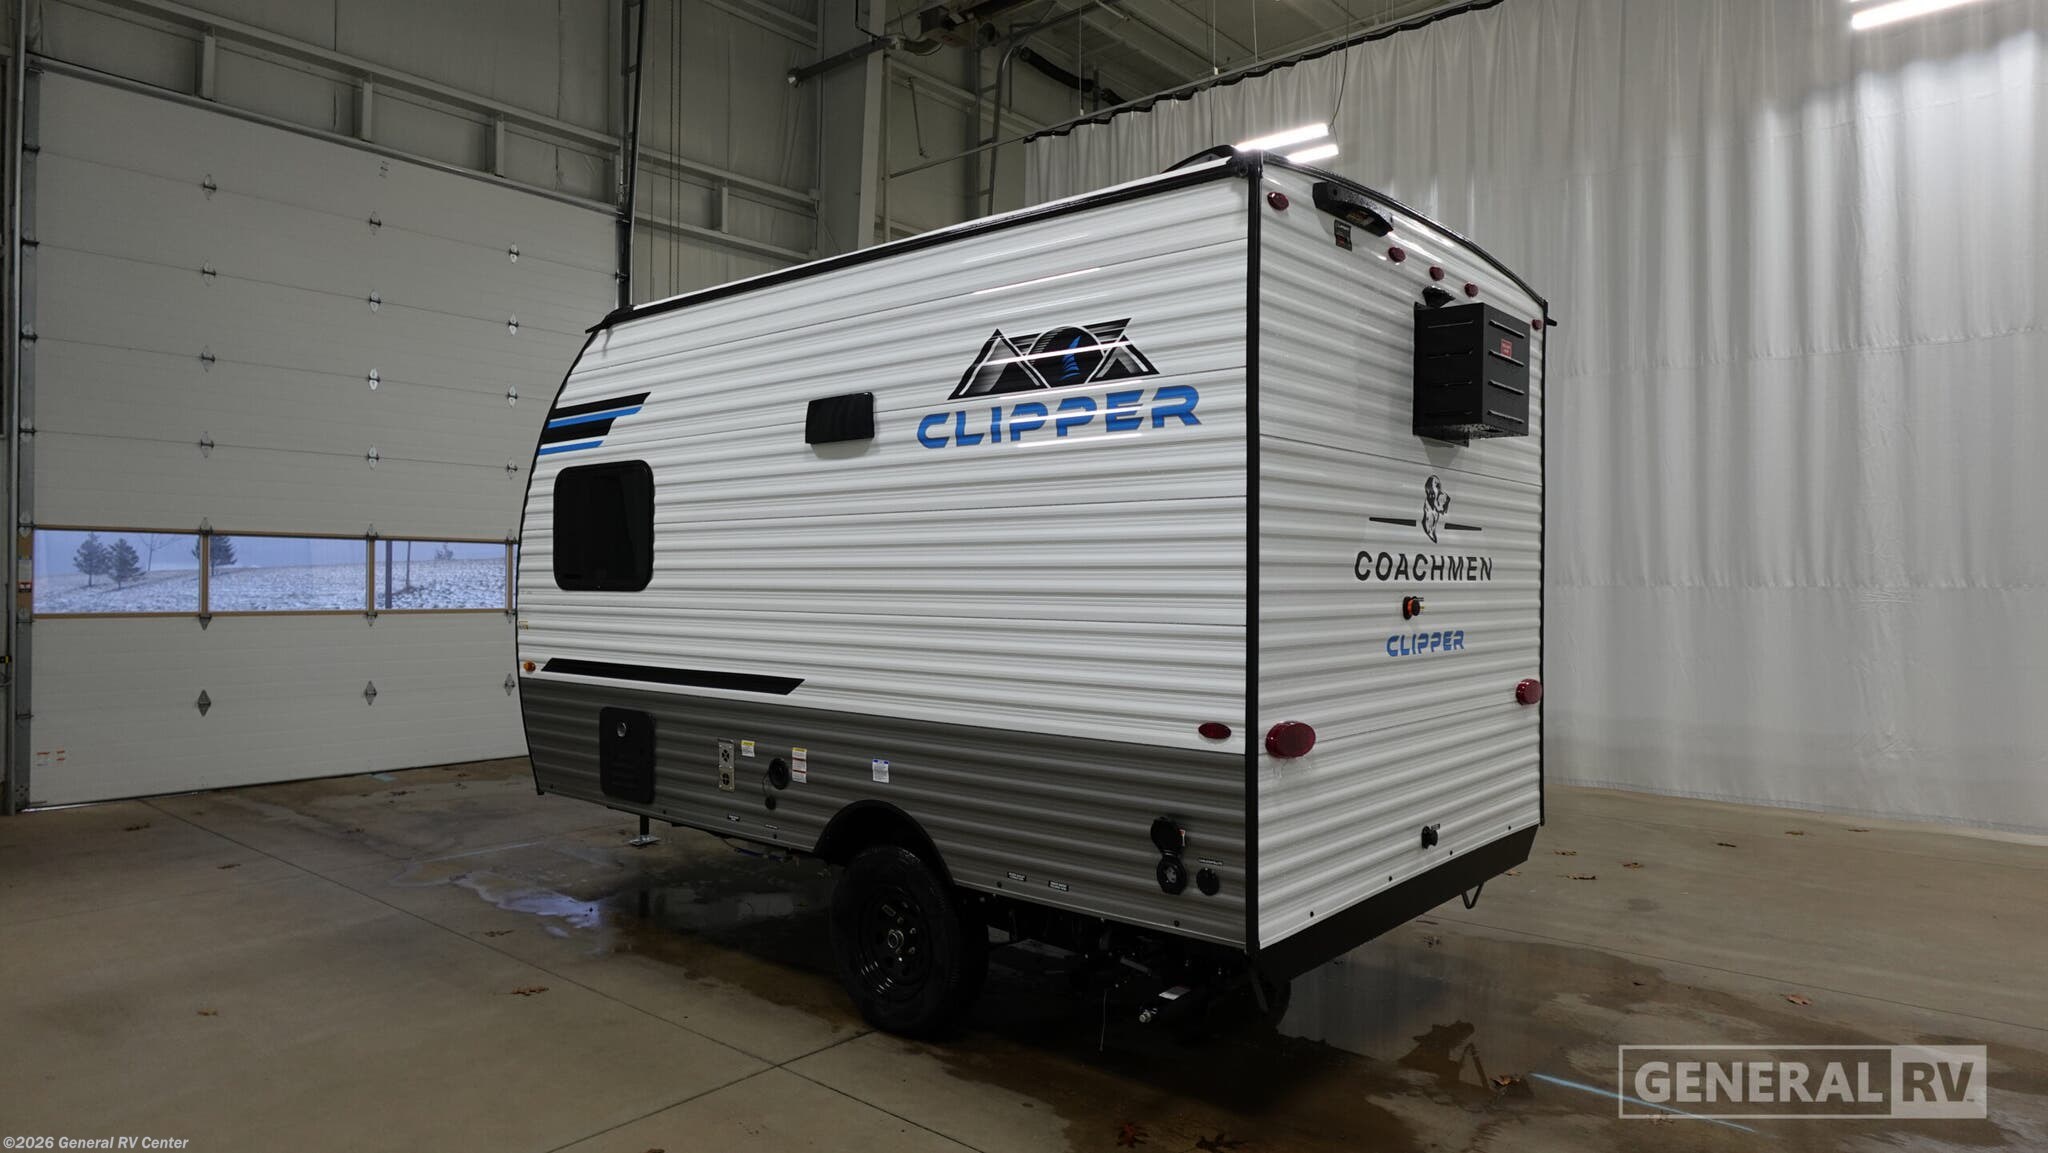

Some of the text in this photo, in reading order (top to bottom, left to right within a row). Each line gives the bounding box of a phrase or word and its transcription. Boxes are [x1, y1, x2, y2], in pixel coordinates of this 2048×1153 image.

[917, 384, 1202, 450] CLIPPER
[1354, 551, 1493, 581] COACHMEN
[1386, 630, 1465, 657] CLIPPER
